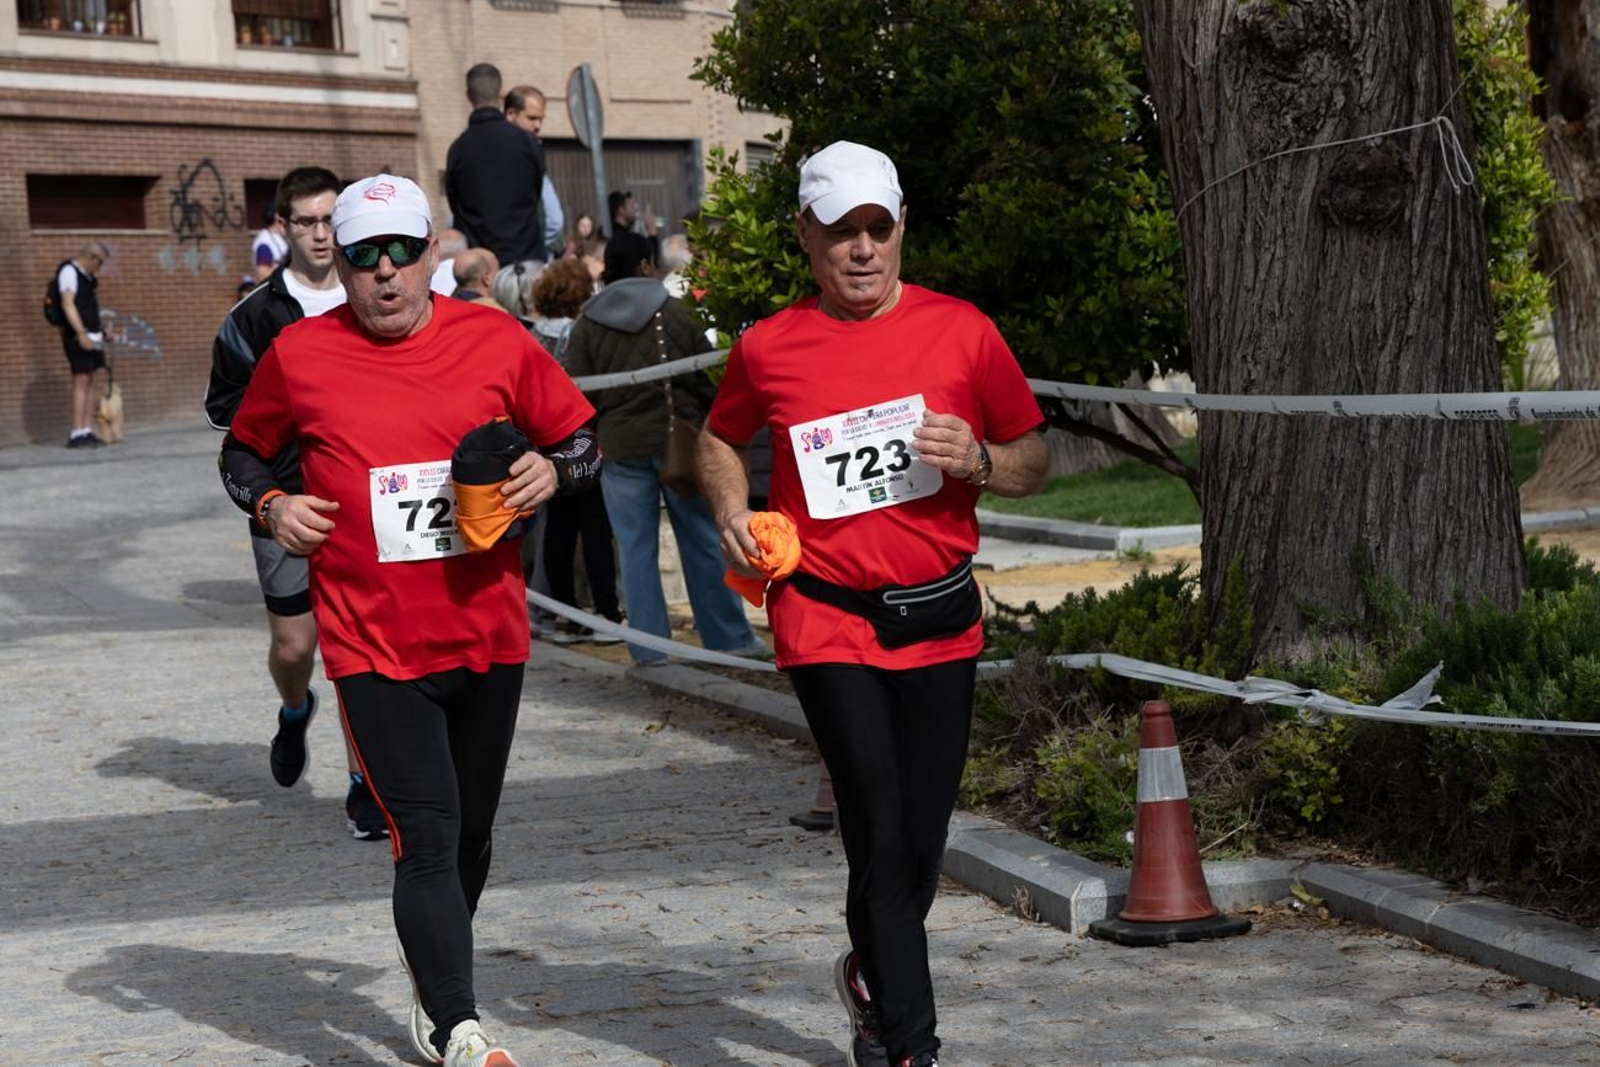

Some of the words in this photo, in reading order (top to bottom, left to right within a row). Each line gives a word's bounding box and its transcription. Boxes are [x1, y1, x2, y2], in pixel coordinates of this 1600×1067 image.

[883, 403, 910, 417] POPULAR
[825, 439, 912, 487] 723
[874, 474, 904, 487] ALFONSO
[420, 530, 438, 539] DIEGO
